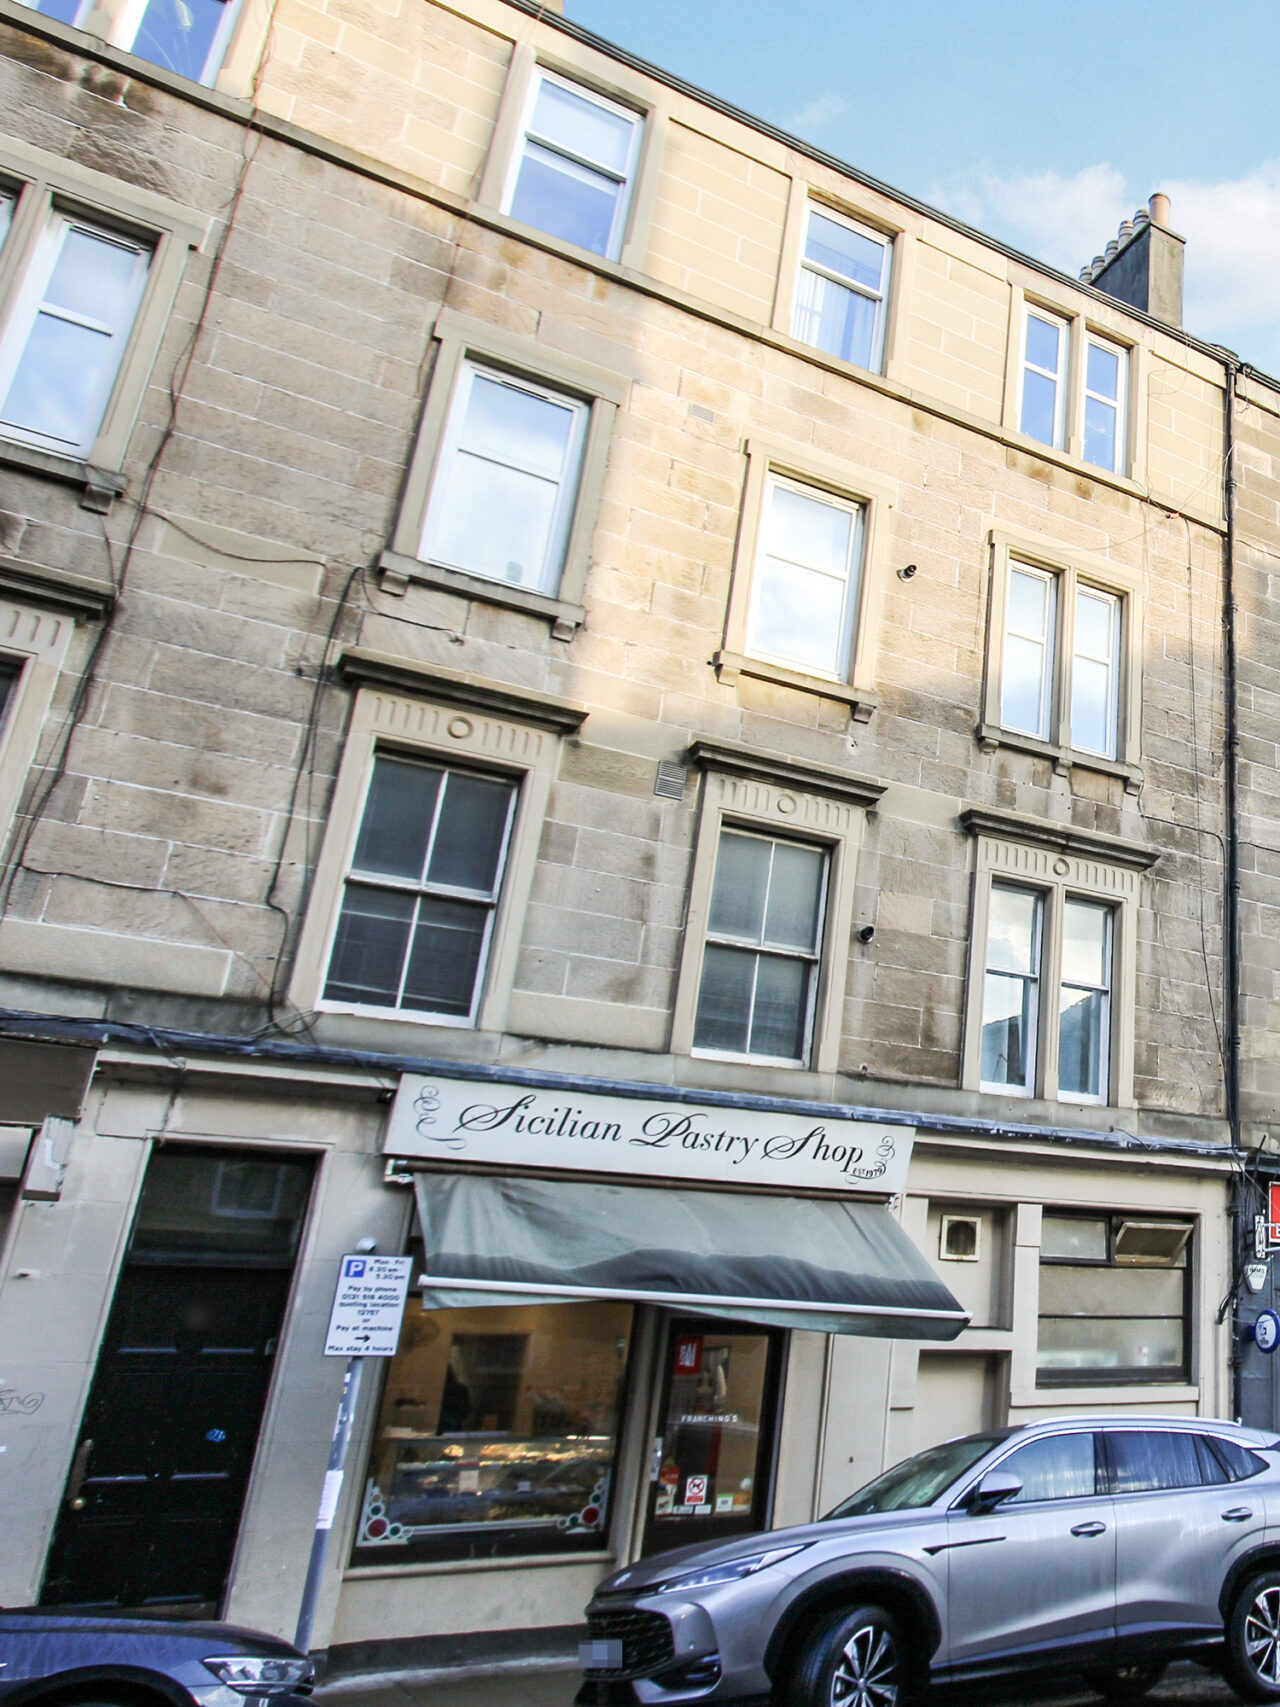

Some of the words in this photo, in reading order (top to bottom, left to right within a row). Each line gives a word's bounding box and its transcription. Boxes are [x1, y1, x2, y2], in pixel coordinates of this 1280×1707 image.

[452, 1094, 622, 1142] Sicilian
[629, 1111, 759, 1165] Pastry
[760, 1126, 864, 1173] Shop
